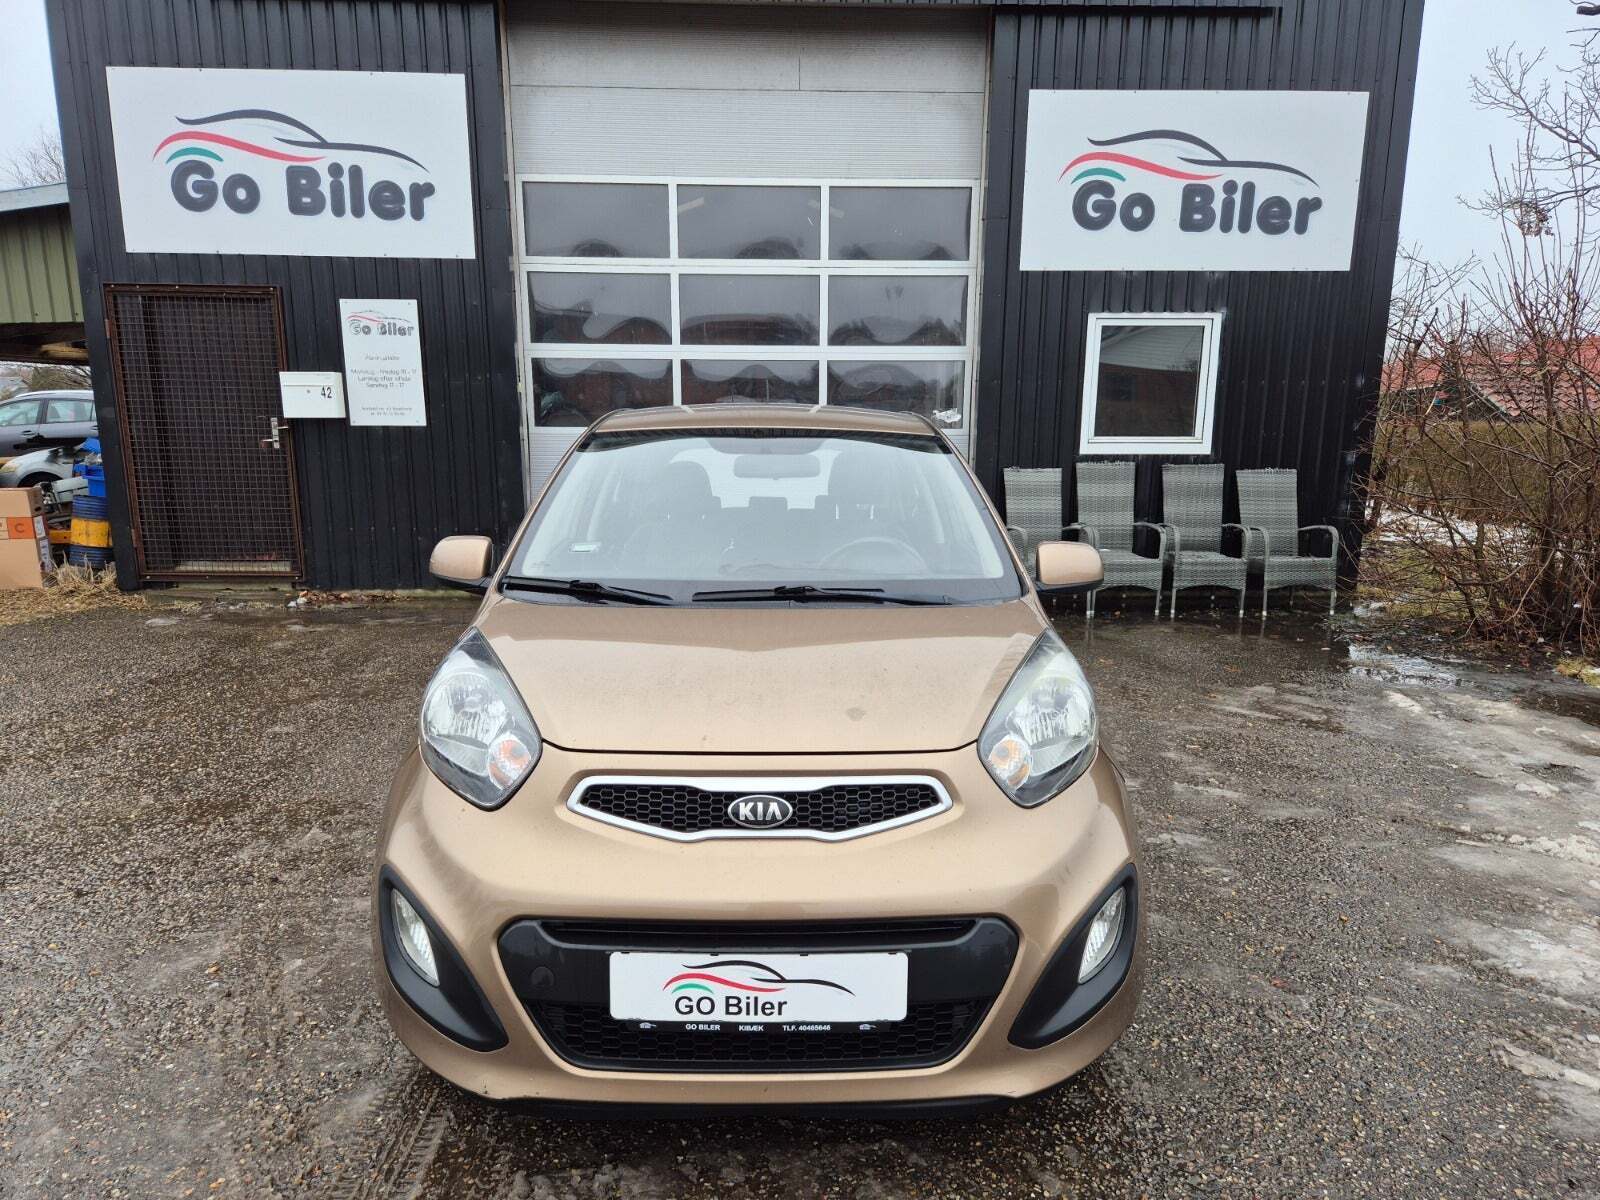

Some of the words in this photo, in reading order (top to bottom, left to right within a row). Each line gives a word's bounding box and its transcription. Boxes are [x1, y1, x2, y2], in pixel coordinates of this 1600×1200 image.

[170, 159, 261, 215] Go
[285, 161, 436, 222] Biler
[1072, 179, 1156, 232] Go
[1179, 179, 1323, 235] Biler
[378, 322, 414, 337] Biler
[320, 386, 333, 399] 42
[738, 801, 783, 821] KIA
[674, 995, 716, 1016] GO
[724, 994, 788, 1017] Biler
[685, 1023, 697, 1031] GO
[698, 1023, 721, 1031] BILER
[782, 1024, 797, 1032] TLF.
